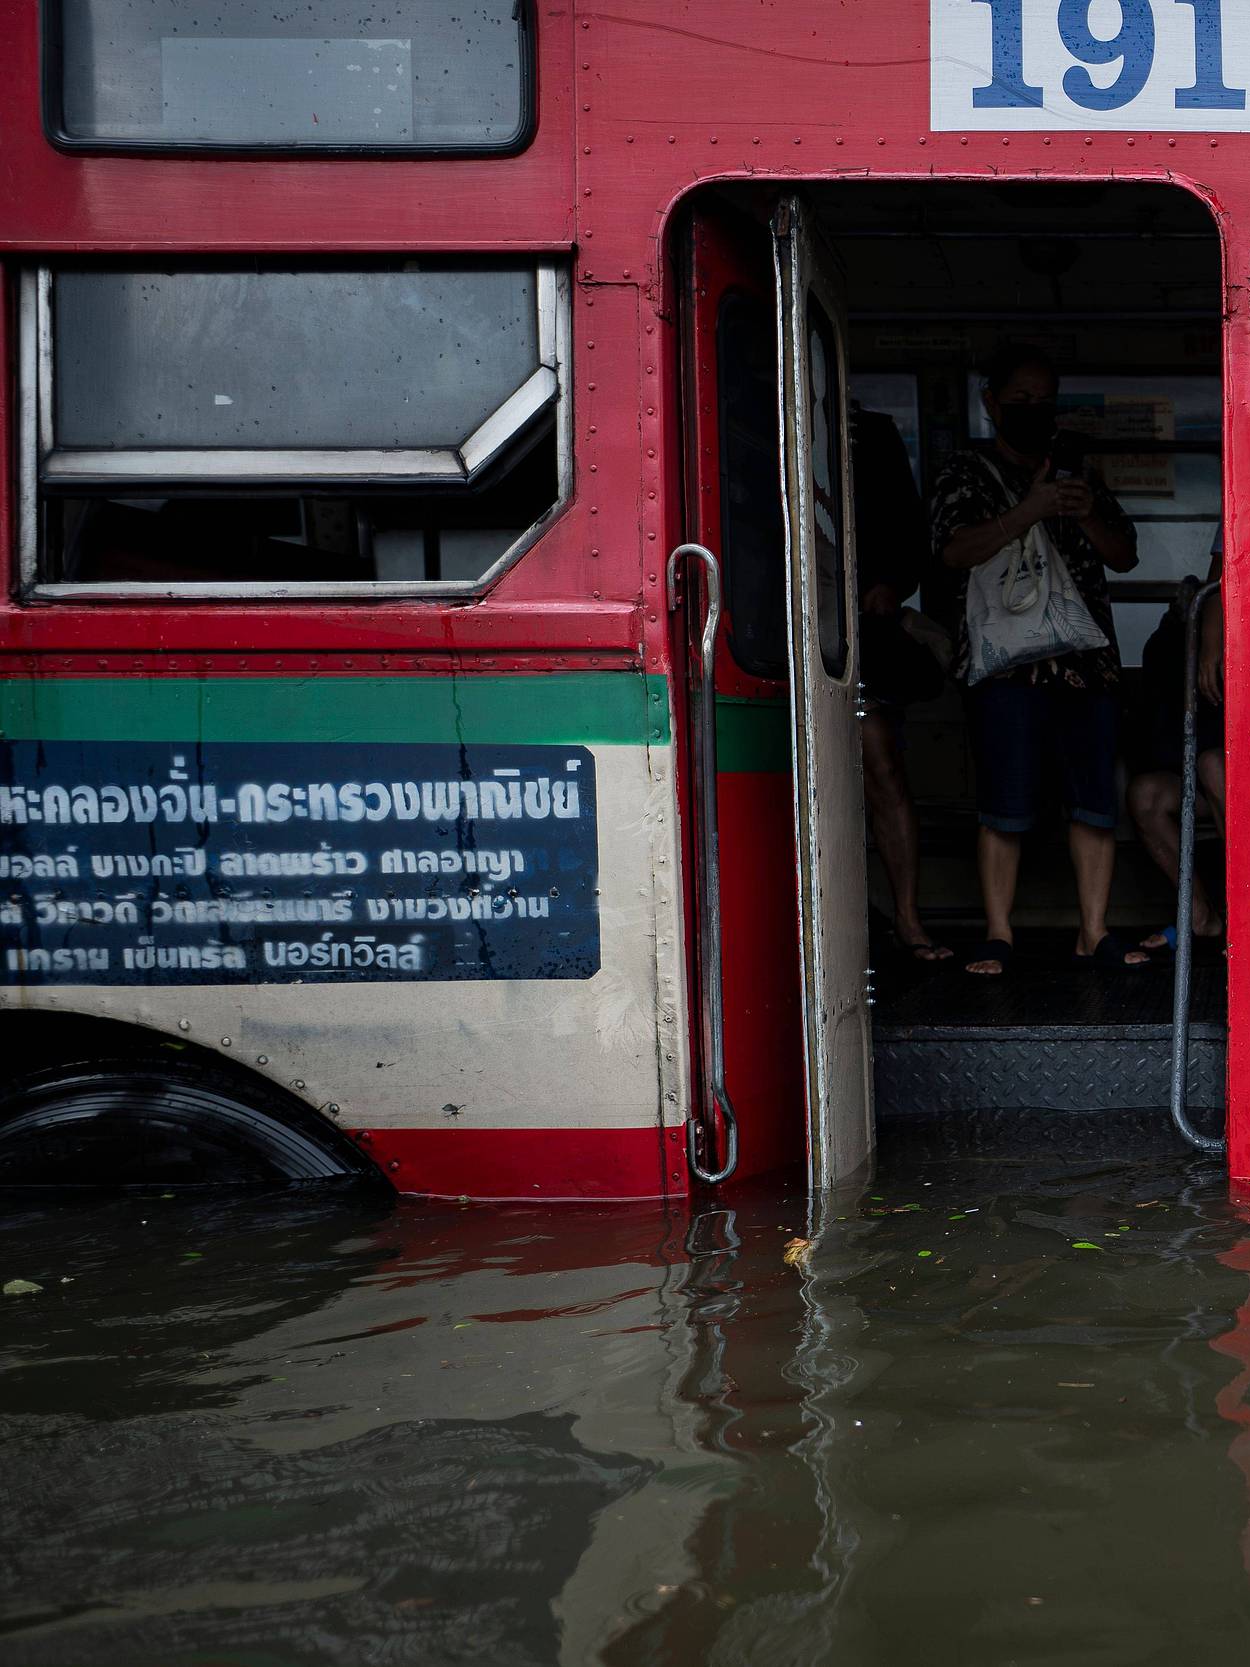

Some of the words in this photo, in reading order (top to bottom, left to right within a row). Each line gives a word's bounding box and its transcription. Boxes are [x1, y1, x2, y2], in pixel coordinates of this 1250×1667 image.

[971, 0, 1246, 111] 191
[220, 841, 367, 877] ลาดพร้าว
[381, 849, 525, 881] ศาลอาญา
[264, 932, 424, 971] นอร์ทวิลล์
